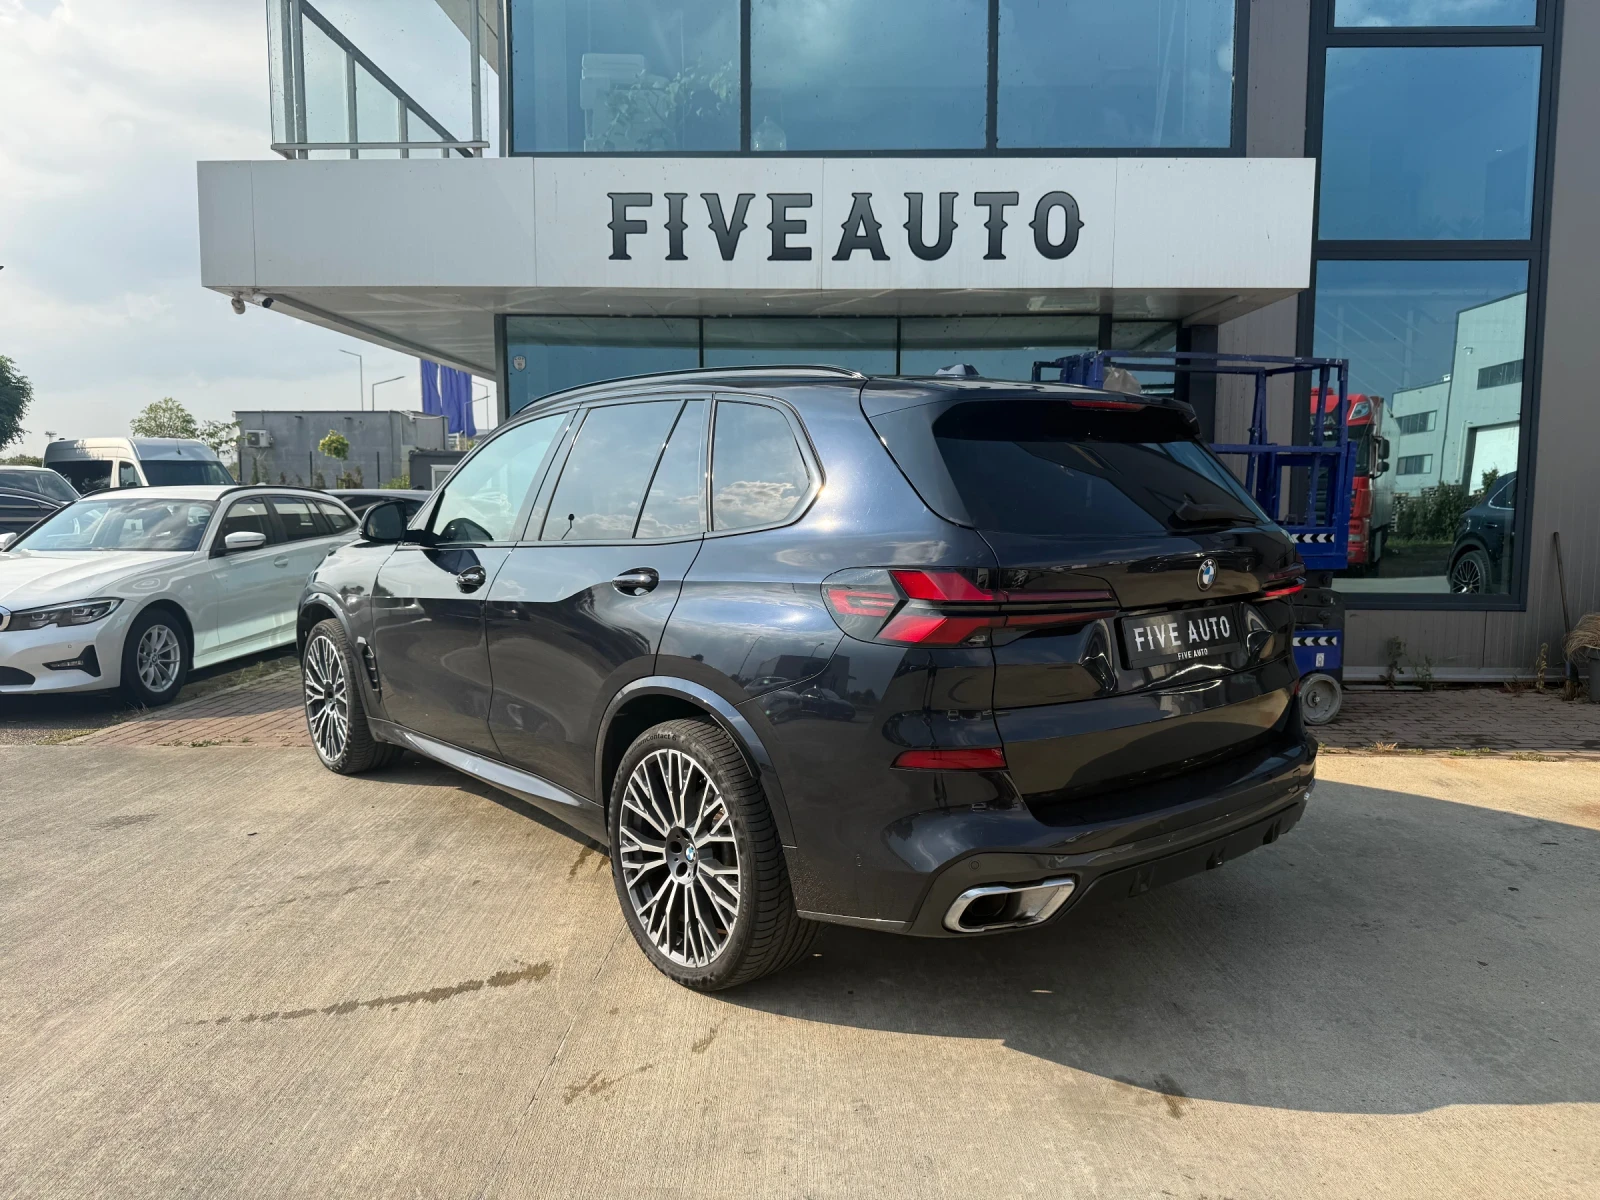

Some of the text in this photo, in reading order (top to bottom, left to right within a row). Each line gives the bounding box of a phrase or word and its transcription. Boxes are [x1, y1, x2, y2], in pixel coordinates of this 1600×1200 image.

[1133, 615, 1231, 653] FIVE AUTO
[1177, 647, 1208, 661] FIVE AUTO
[672, 733, 677, 741] 6
